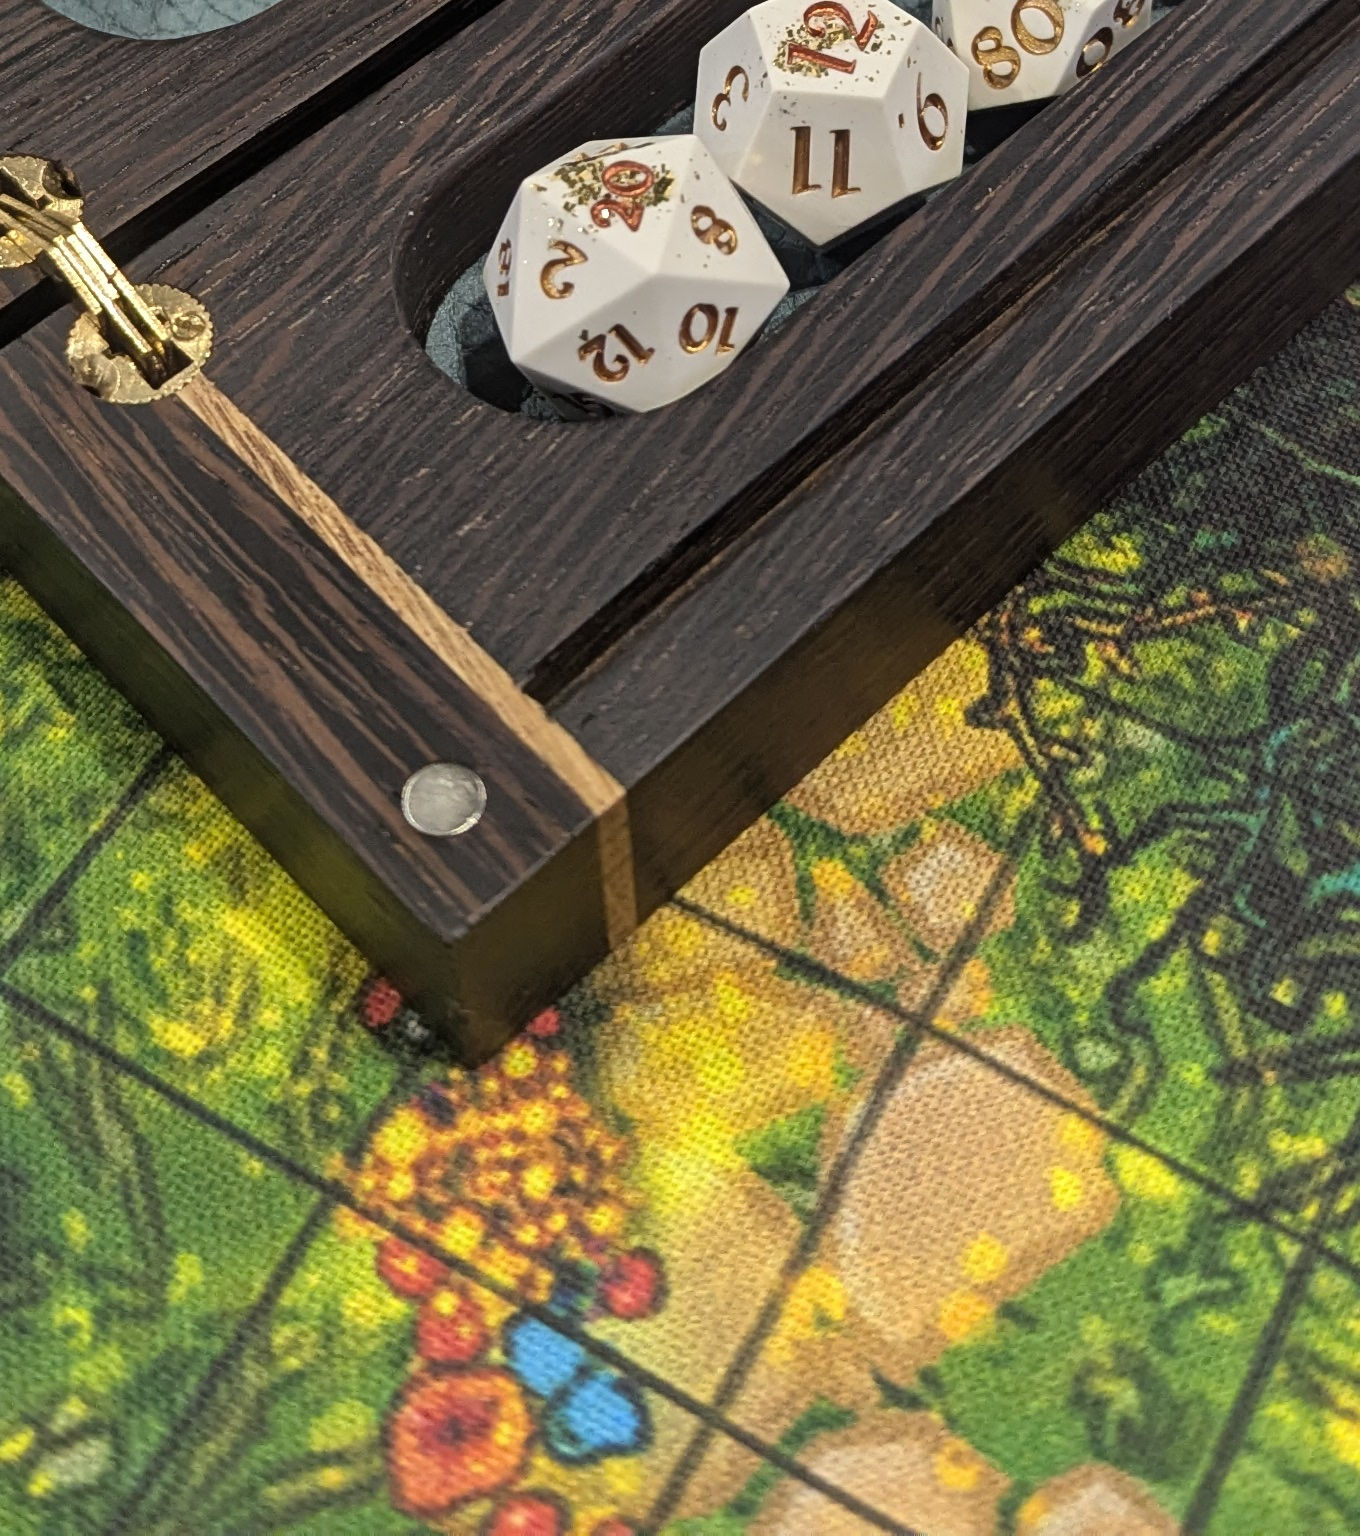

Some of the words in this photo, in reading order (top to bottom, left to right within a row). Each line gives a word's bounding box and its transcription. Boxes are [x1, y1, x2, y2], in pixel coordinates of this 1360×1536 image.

[787, 1, 878, 75] 12
[790, 126, 862, 198] 11
[590, 161, 654, 232] 20
[691, 206, 738, 255] 8
[540, 240, 588, 299] 2
[578, 324, 654, 382] 12
[678, 303, 739, 356] 10
